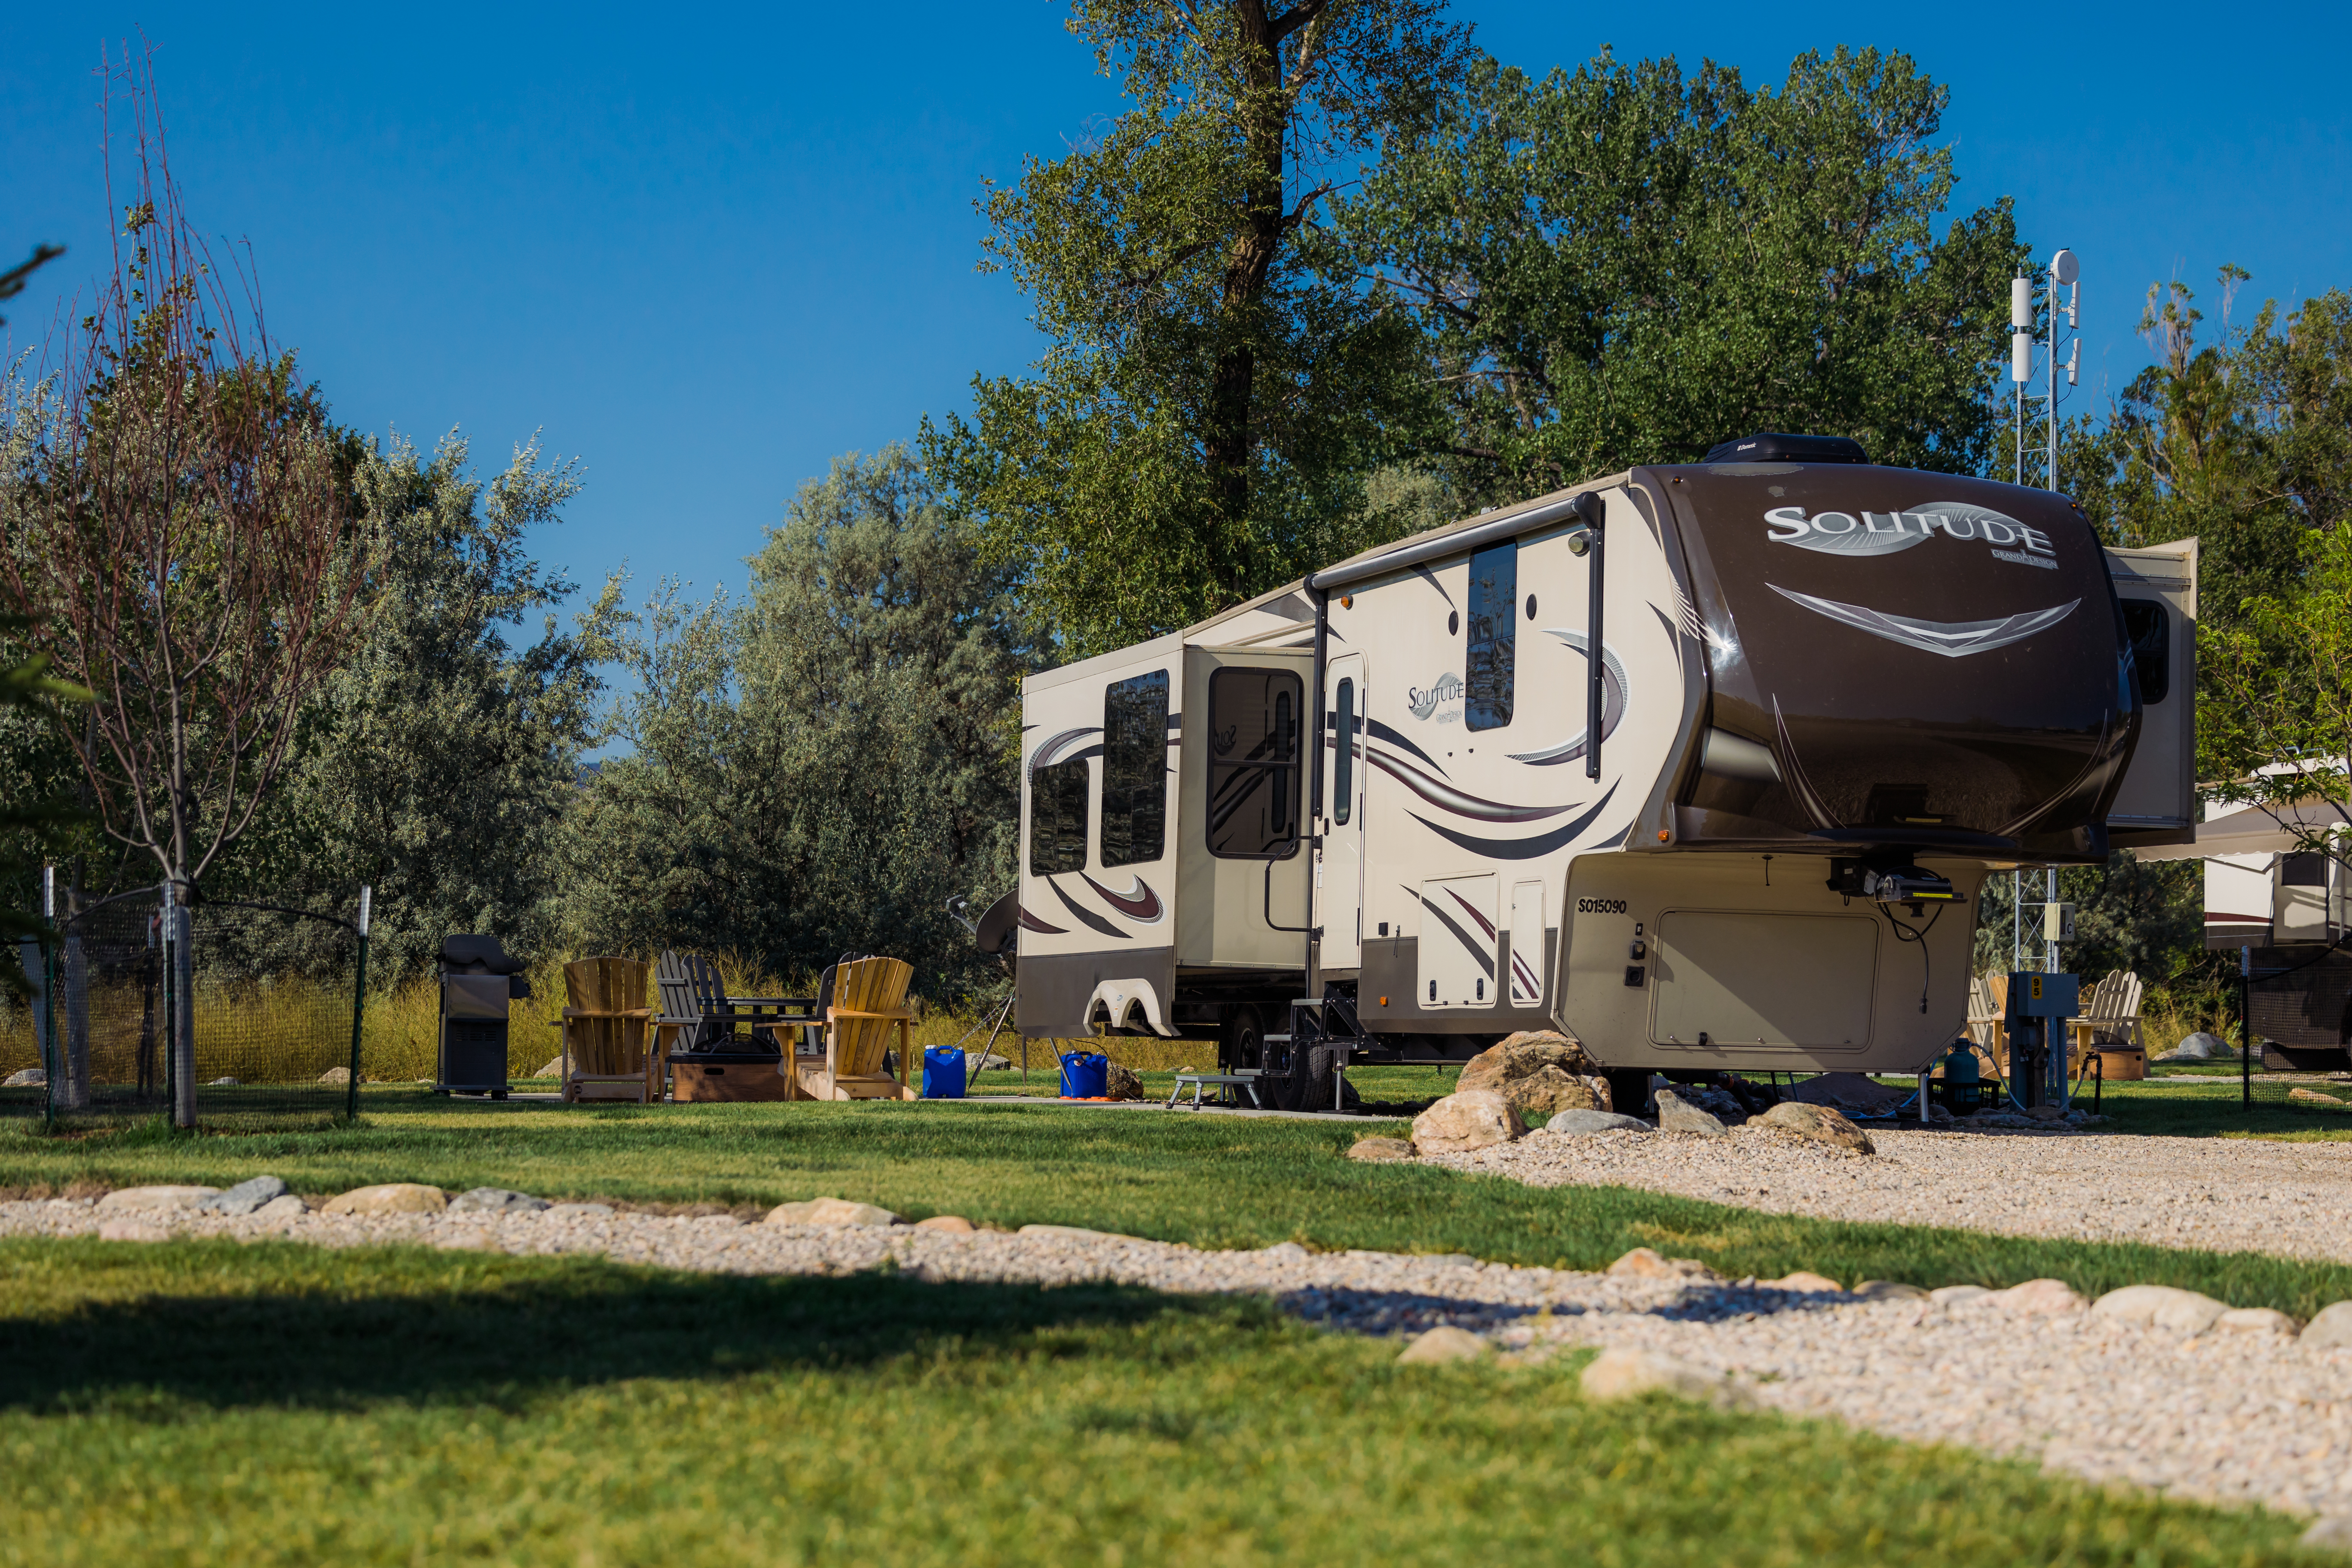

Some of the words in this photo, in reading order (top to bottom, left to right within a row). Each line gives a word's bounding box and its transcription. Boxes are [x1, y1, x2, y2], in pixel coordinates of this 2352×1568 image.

[1741, 442, 1757, 450] Dometic
[1764, 507, 2054, 554] SOLITUDE
[1408, 682, 1464, 709] SOLITUDE
[2067, 923, 2072, 934] C
[2034, 978, 2040, 996] 95
